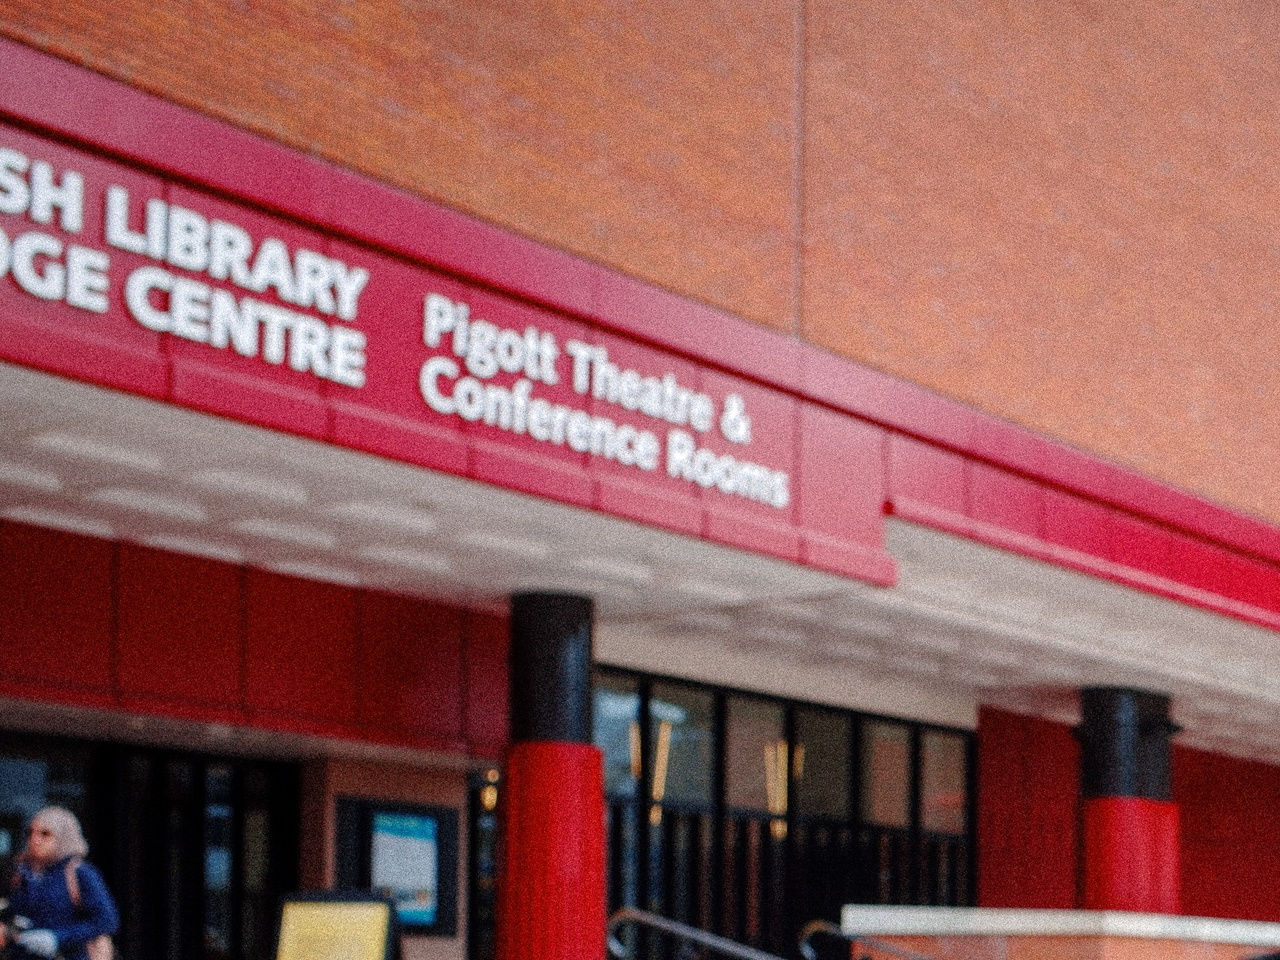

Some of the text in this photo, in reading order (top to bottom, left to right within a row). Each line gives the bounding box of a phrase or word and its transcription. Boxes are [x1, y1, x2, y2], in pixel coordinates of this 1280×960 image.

[0, 147, 370, 320] SH LIBRARY
[0, 227, 366, 388] GE CENTRE
[419, 356, 790, 508] Conference Rooms
[423, 292, 753, 444] Pigott Theatre &
